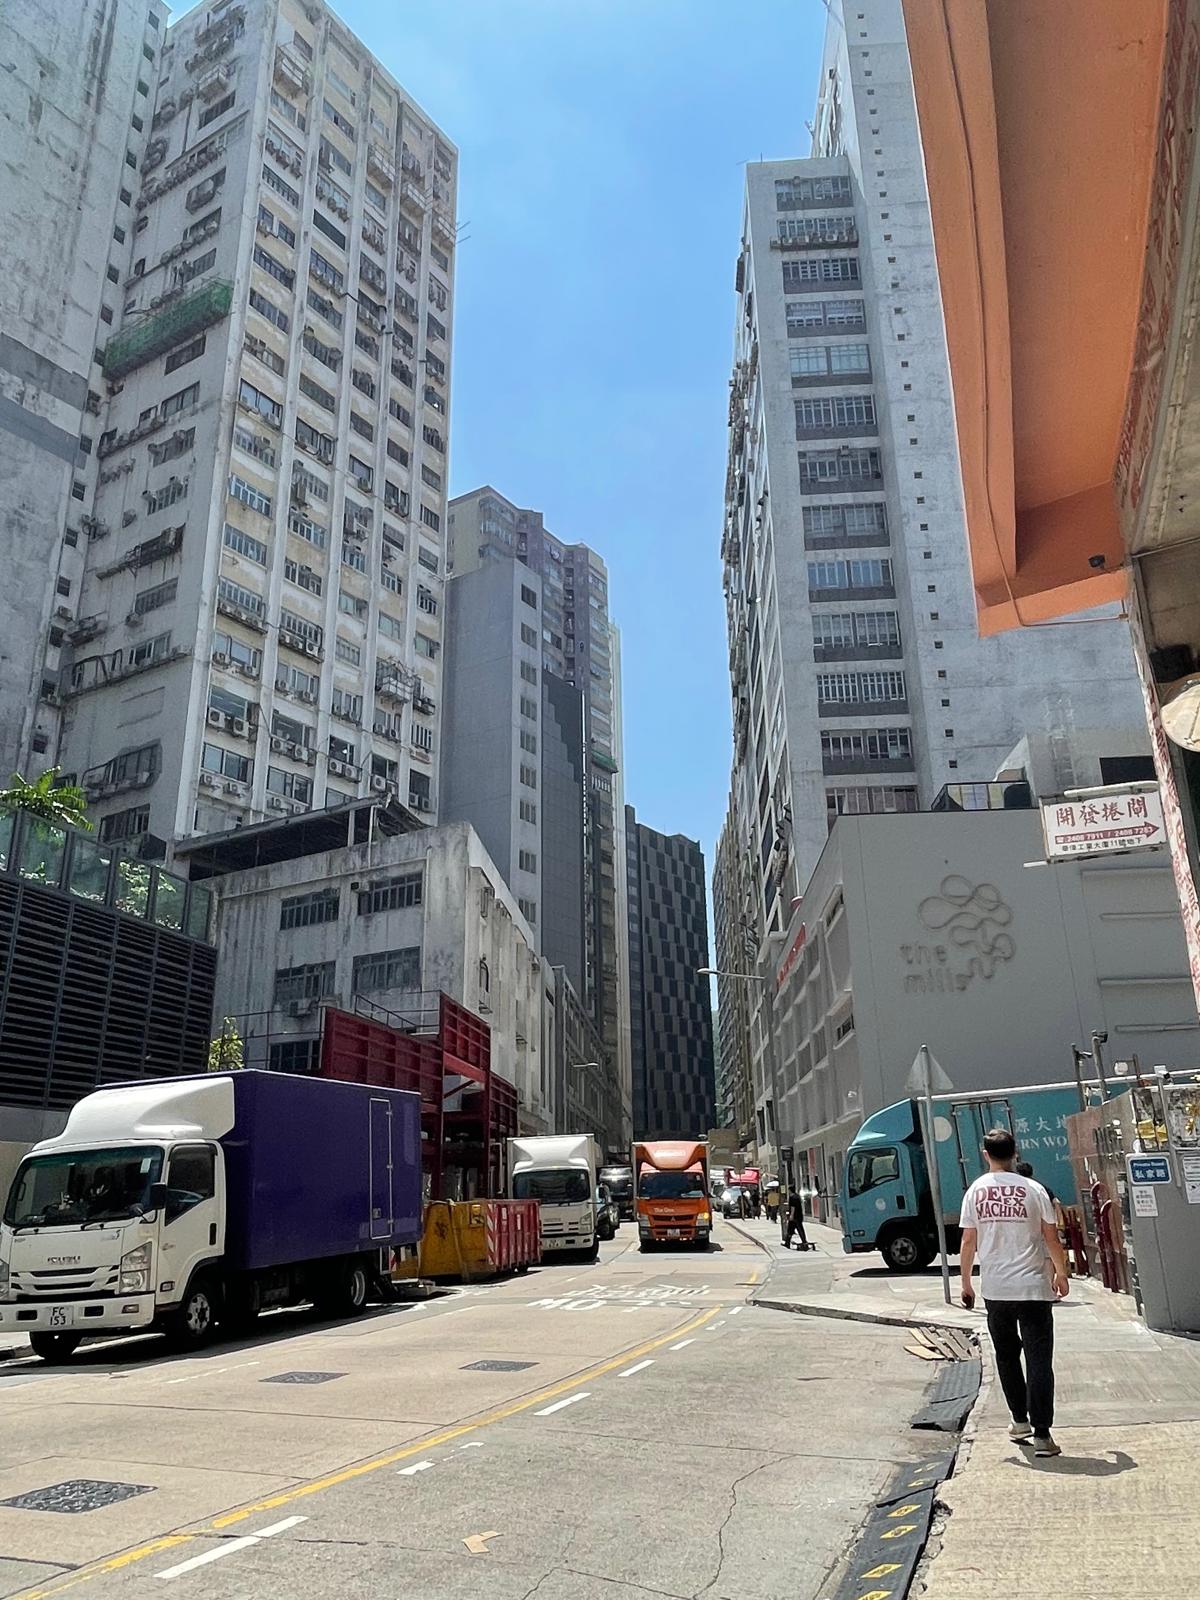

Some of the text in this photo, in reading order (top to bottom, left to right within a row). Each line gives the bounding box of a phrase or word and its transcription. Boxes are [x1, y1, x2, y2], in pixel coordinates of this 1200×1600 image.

[1056, 796, 1148, 827] 開發捲閘
[975, 1185, 1026, 1206] DEUS
[1003, 1197, 1024, 1207] EX
[975, 1201, 1028, 1220] MACHINA
[52, 1306, 65, 1317] FC
[50, 1315, 66, 1326] 153
